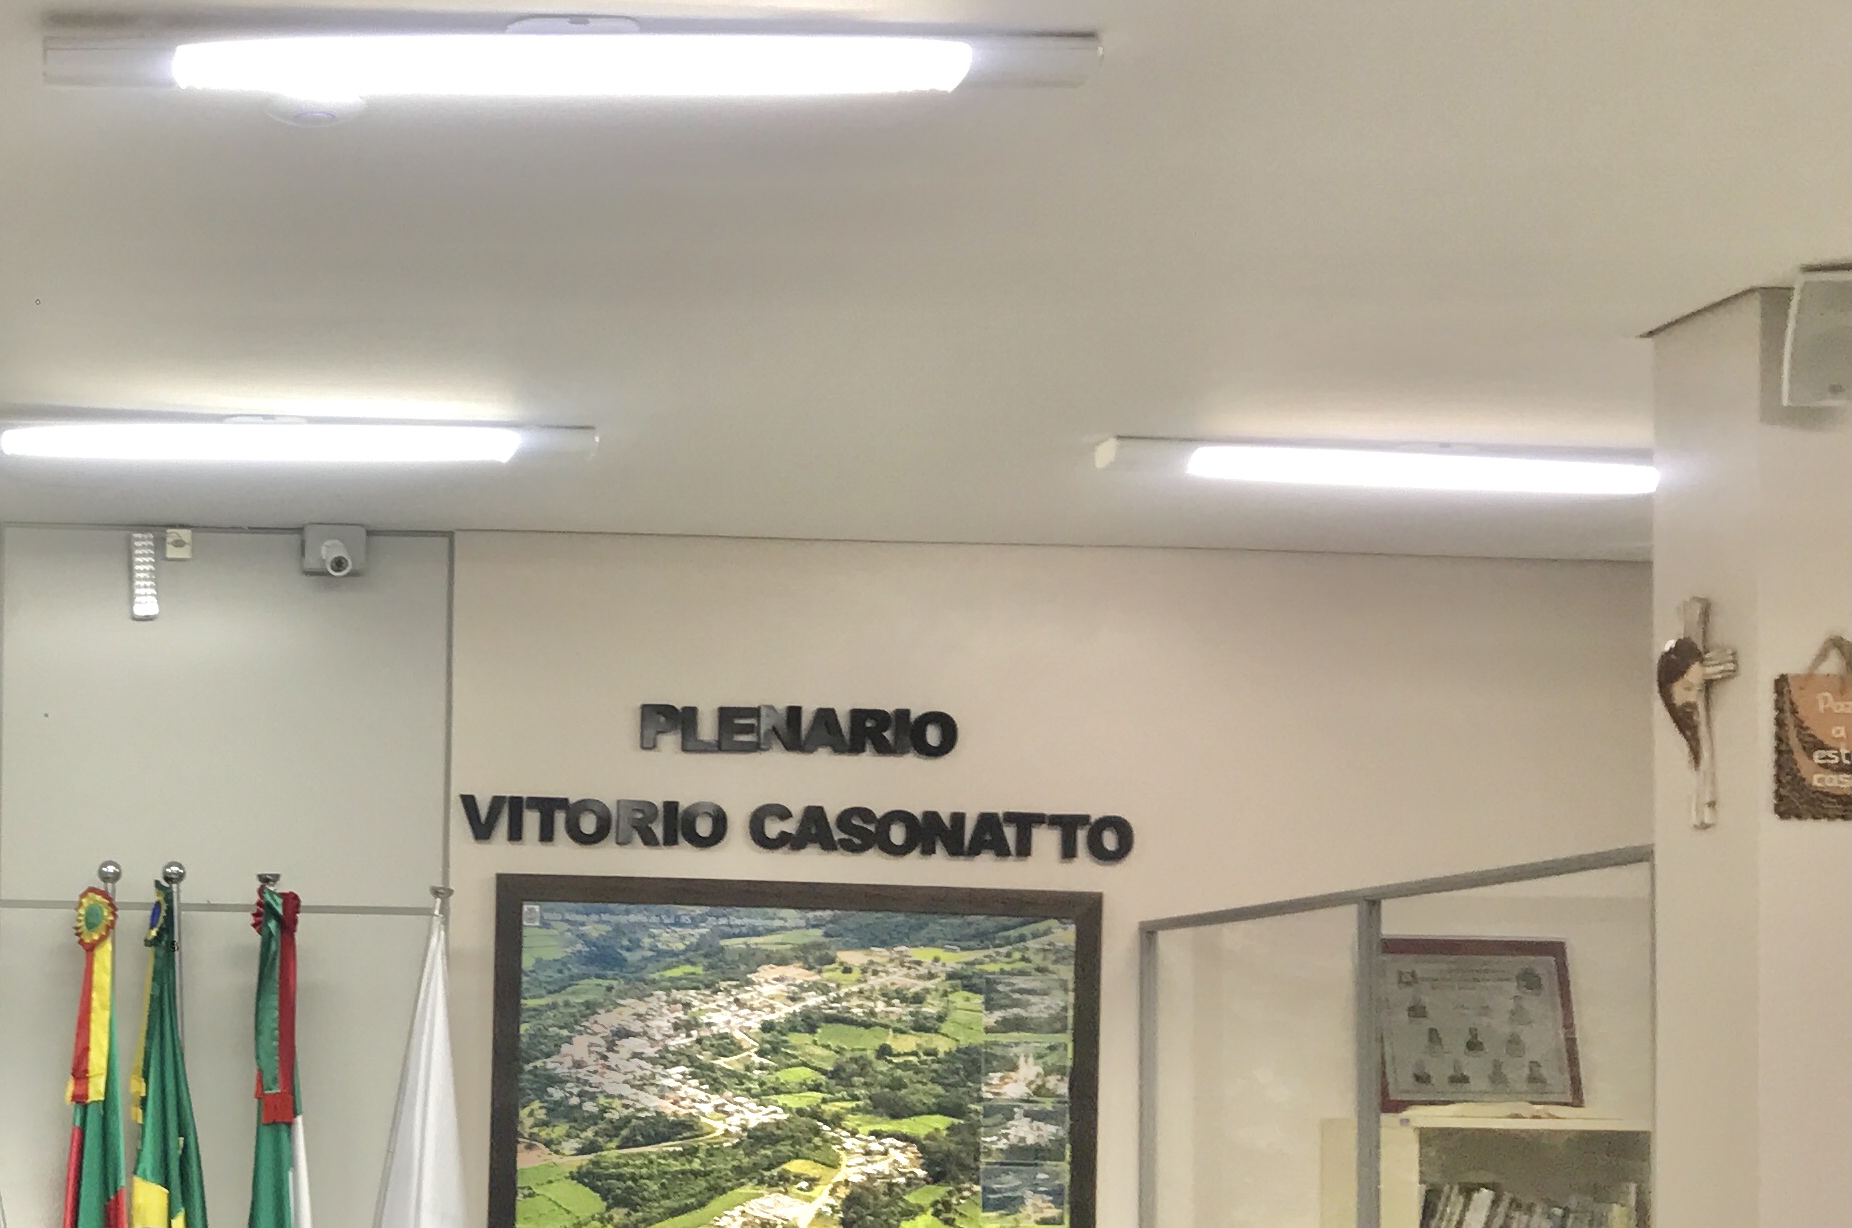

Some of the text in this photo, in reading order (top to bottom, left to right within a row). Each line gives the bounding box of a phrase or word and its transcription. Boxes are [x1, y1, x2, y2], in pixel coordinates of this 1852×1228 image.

[639, 703, 959, 760] PLENARIO
[459, 793, 1135, 865] VITORIO CASONATTO
